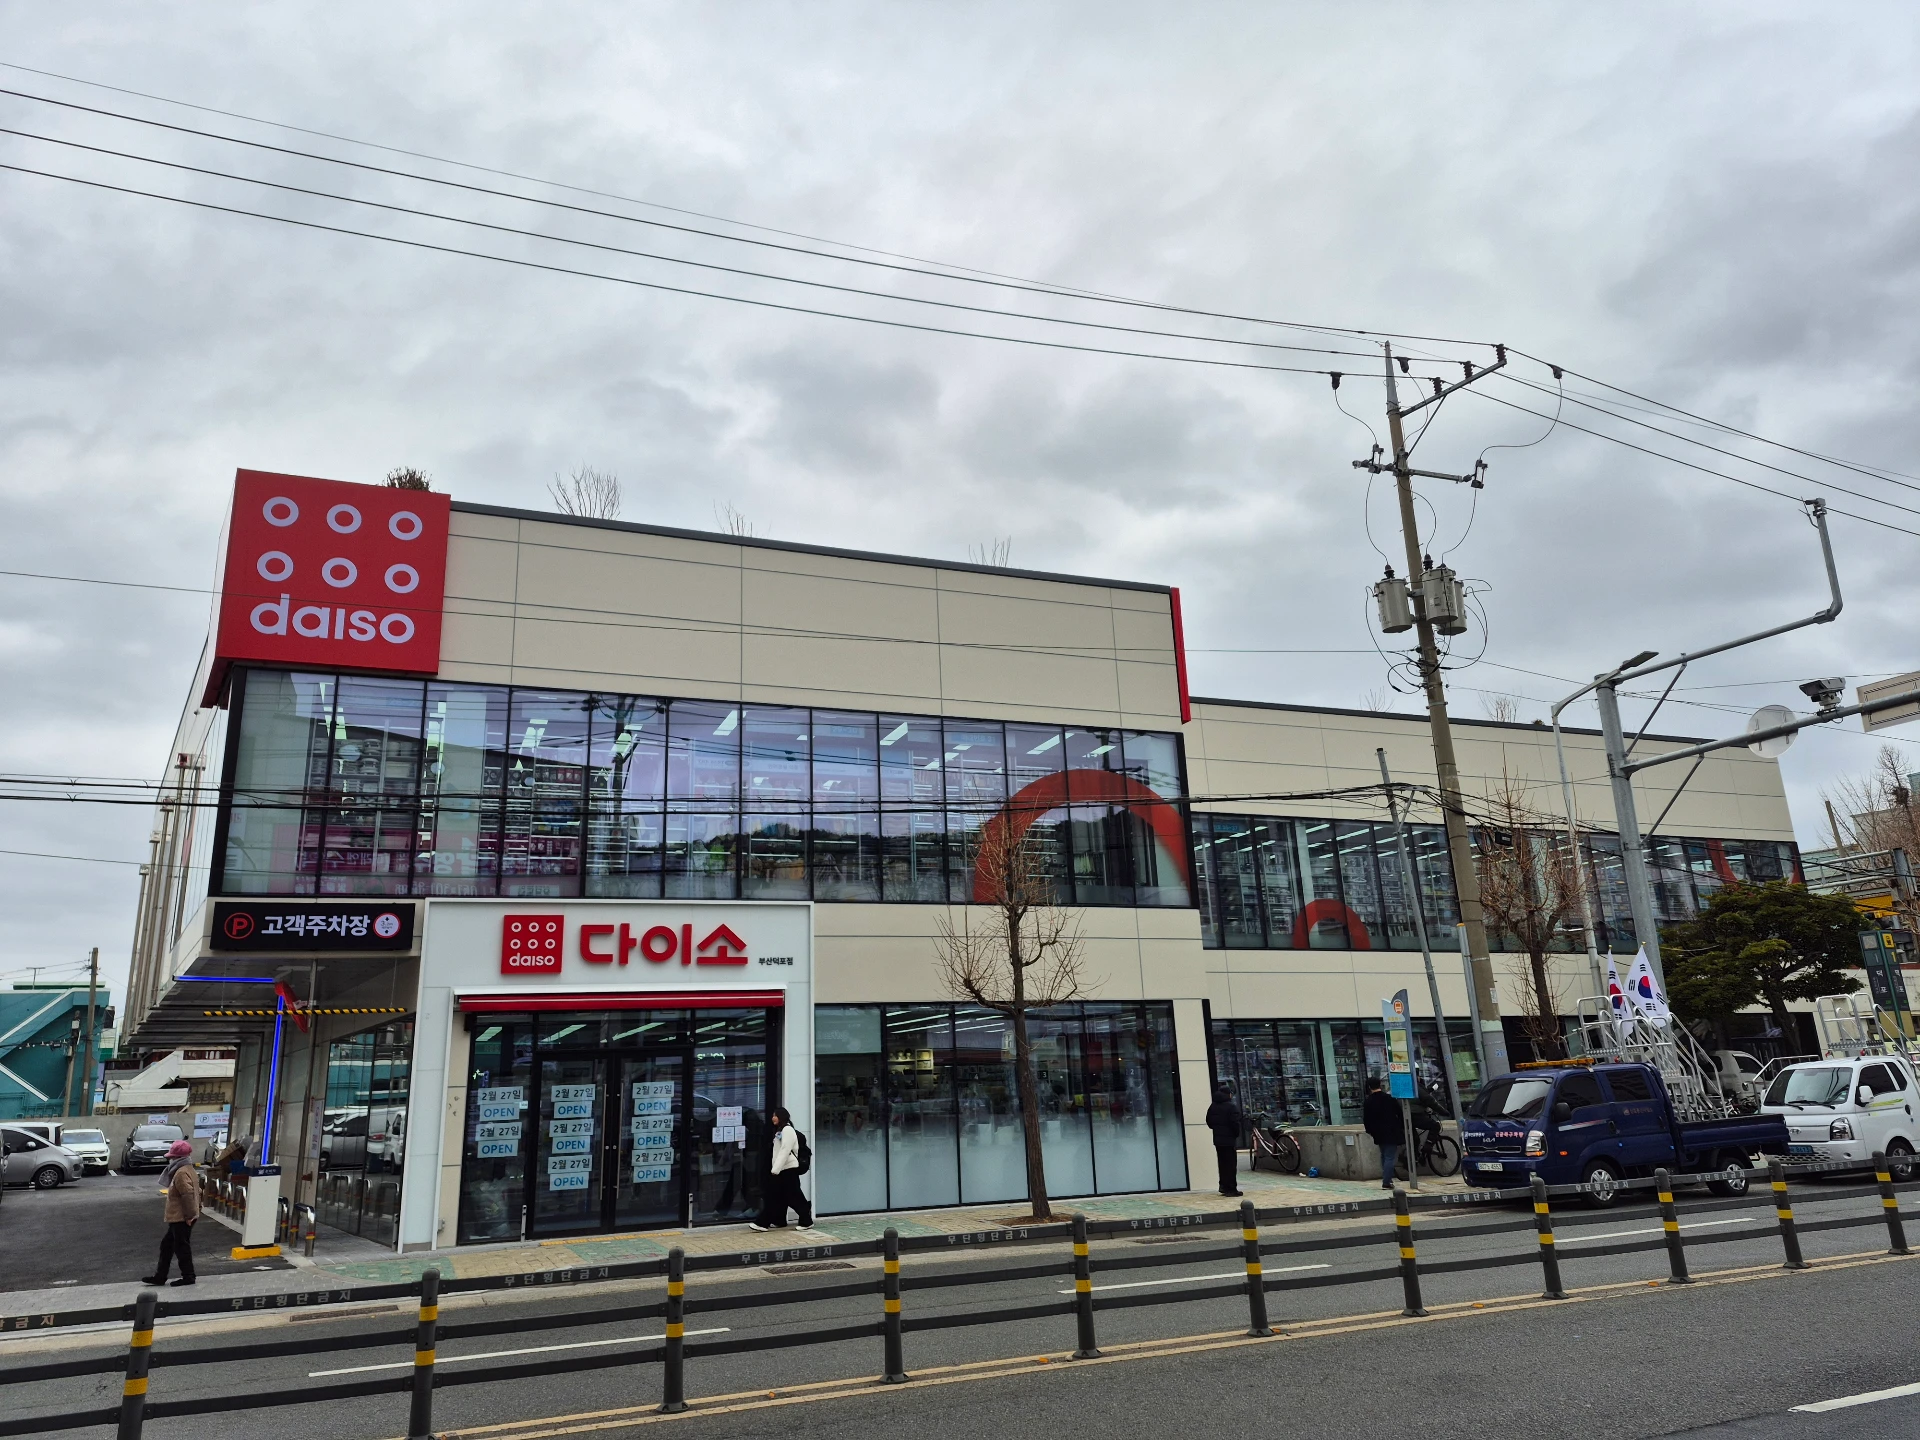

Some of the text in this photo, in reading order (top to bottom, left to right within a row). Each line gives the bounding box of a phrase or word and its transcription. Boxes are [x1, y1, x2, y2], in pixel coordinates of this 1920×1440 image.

[249, 593, 415, 644] daiso
[261, 914, 371, 937] 고객주차장
[580, 923, 749, 966] 다이소
[508, 952, 555, 967] daiso
[758, 956, 794, 967] 부산덕포점
[482, 1090, 520, 1101] 2월 27일
[555, 1088, 593, 1099] 2월 27일
[636, 1085, 672, 1096] 2월 27일
[558, 1106, 587, 1115] OPEN
[638, 1102, 667, 1112] OPEN
[483, 1108, 515, 1118] OPEN
[553, 1123, 592, 1133] 2월 27일
[635, 1118, 672, 1130] 2월 27일
[480, 1126, 519, 1137] 2월 27일
[556, 1140, 586, 1150] OPEN
[637, 1136, 666, 1146] OPEN
[482, 1144, 513, 1155] OPEN
[635, 1151, 672, 1163] 2월 27일
[552, 1158, 590, 1170] 2월 27일
[637, 1169, 667, 1179] OPEN
[553, 1176, 584, 1187] OPEN
[741, 1246, 833, 1265] 무단횡단금지
[504, 1266, 609, 1287] 무단횡단금지
[231, 1289, 351, 1310] 무단횡단금지
